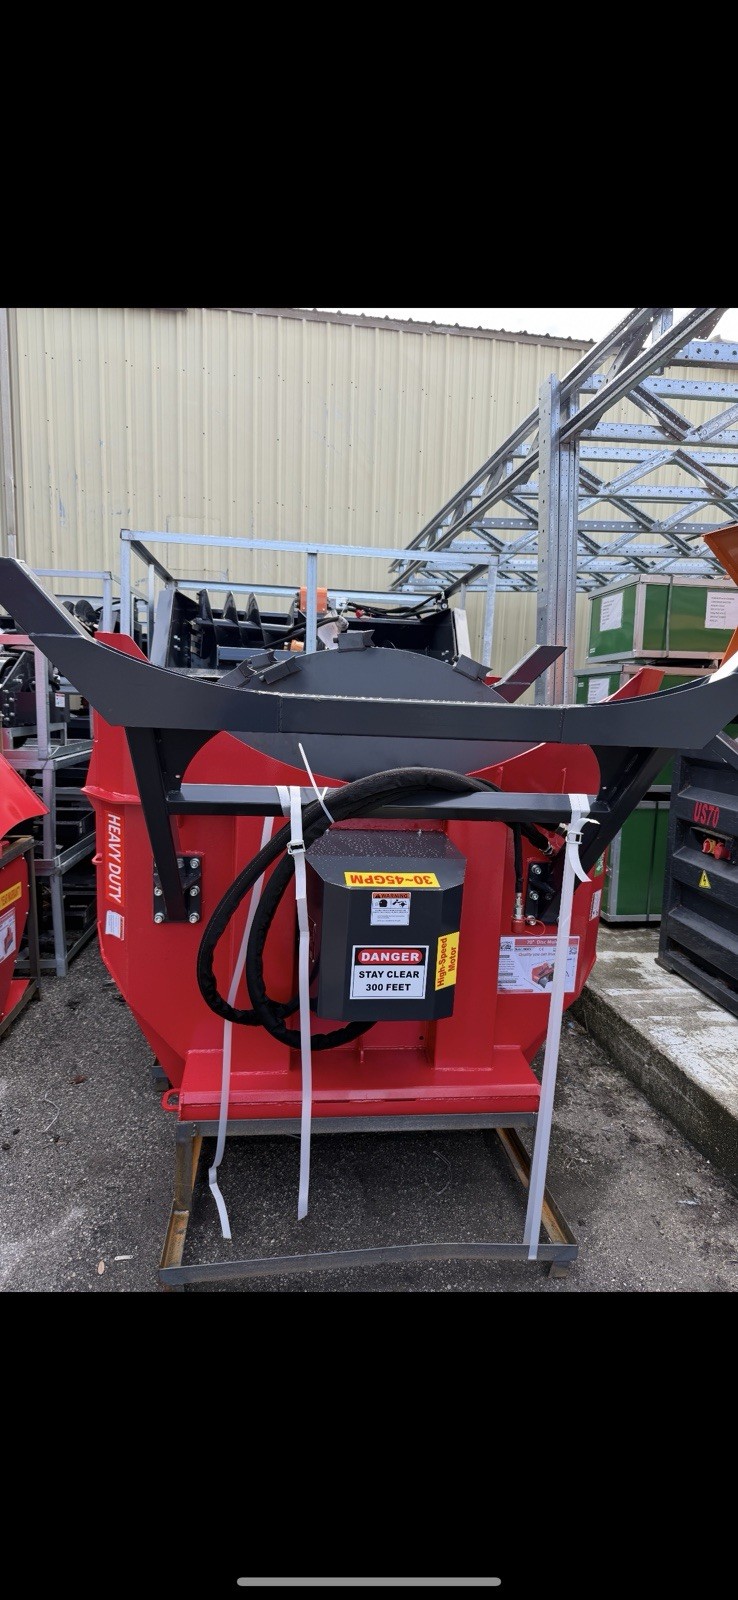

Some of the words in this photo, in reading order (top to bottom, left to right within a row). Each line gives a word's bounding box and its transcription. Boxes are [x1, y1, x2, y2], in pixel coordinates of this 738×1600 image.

[694, 801, 720, 828] US70
[108, 813, 121, 862] HEAVY
[108, 863, 122, 903] DUTY
[350, 874, 433, 885] 30~45GPM
[362, 952, 420, 962] DANGER
[437, 937, 448, 987] High-Speed
[448, 946, 457, 973] Motor
[358, 970, 384, 979] STAY
[386, 970, 420, 979] CLEAR
[365, 983, 384, 992] 300
[386, 983, 411, 992] FEET
